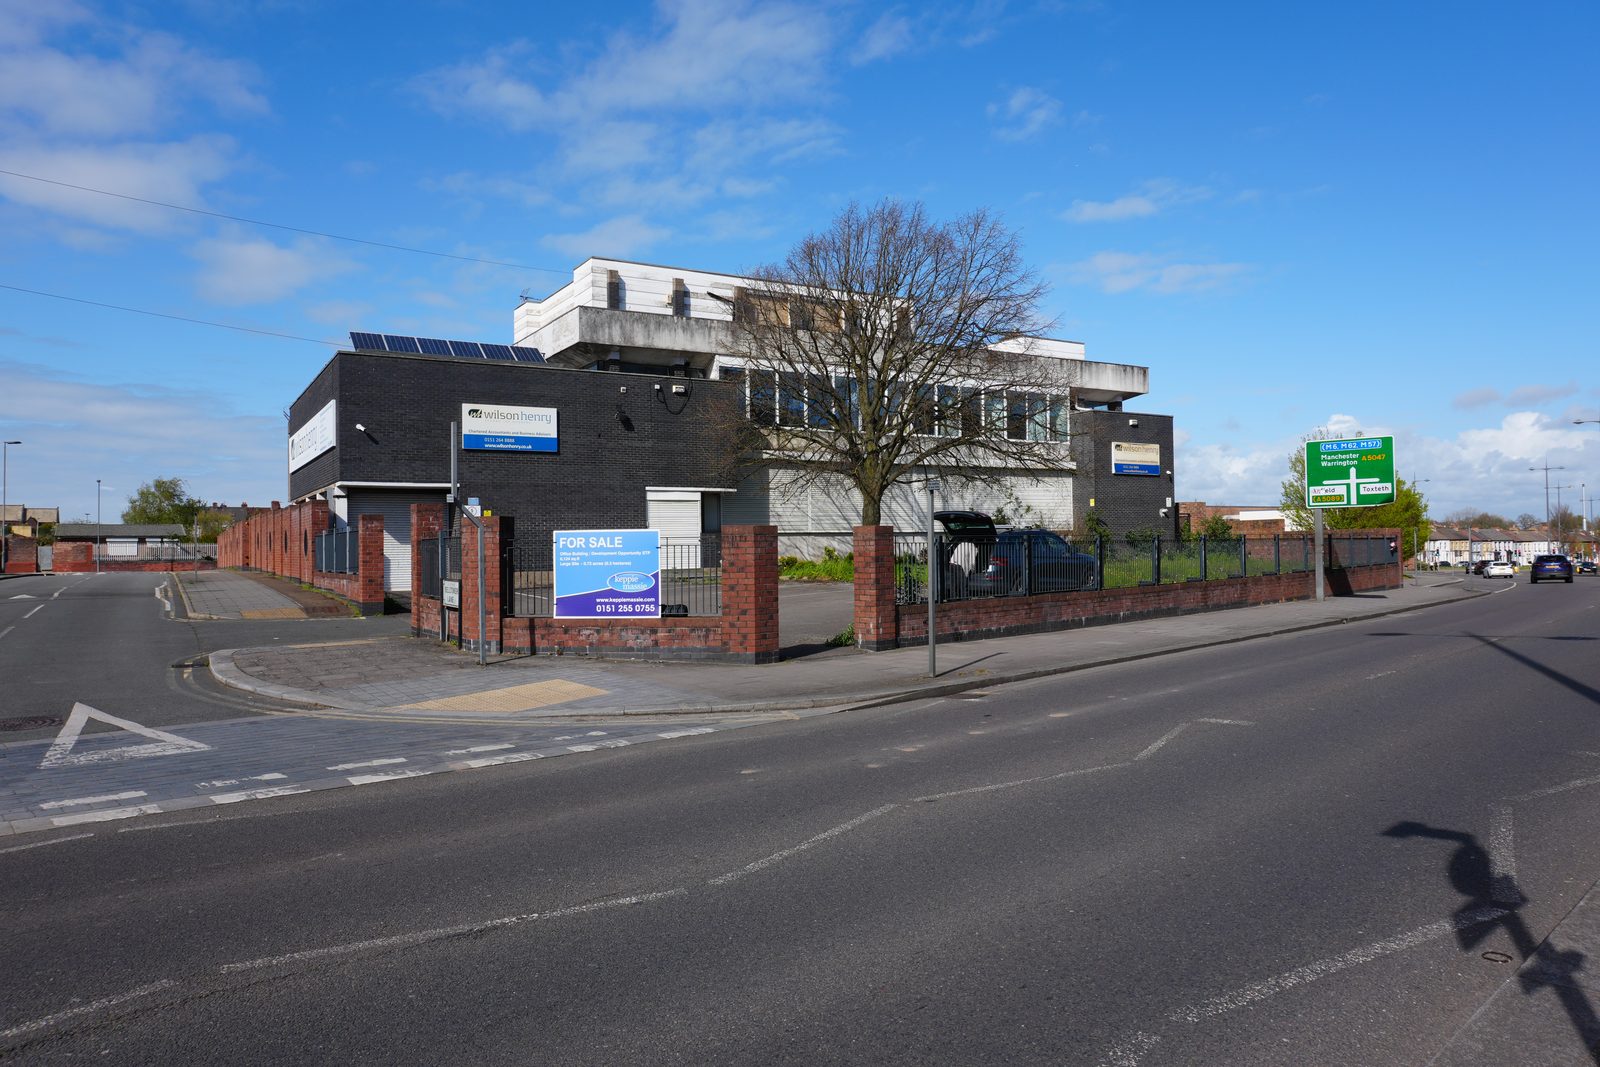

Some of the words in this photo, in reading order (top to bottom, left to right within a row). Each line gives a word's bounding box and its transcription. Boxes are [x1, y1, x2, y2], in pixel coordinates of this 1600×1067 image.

[559, 537, 586, 549] FOR
[588, 536, 623, 548] SALE
[614, 575, 639, 584] keppie
[622, 582, 648, 590] massie
[618, 604, 633, 612] 255
[635, 604, 656, 612] 0755
